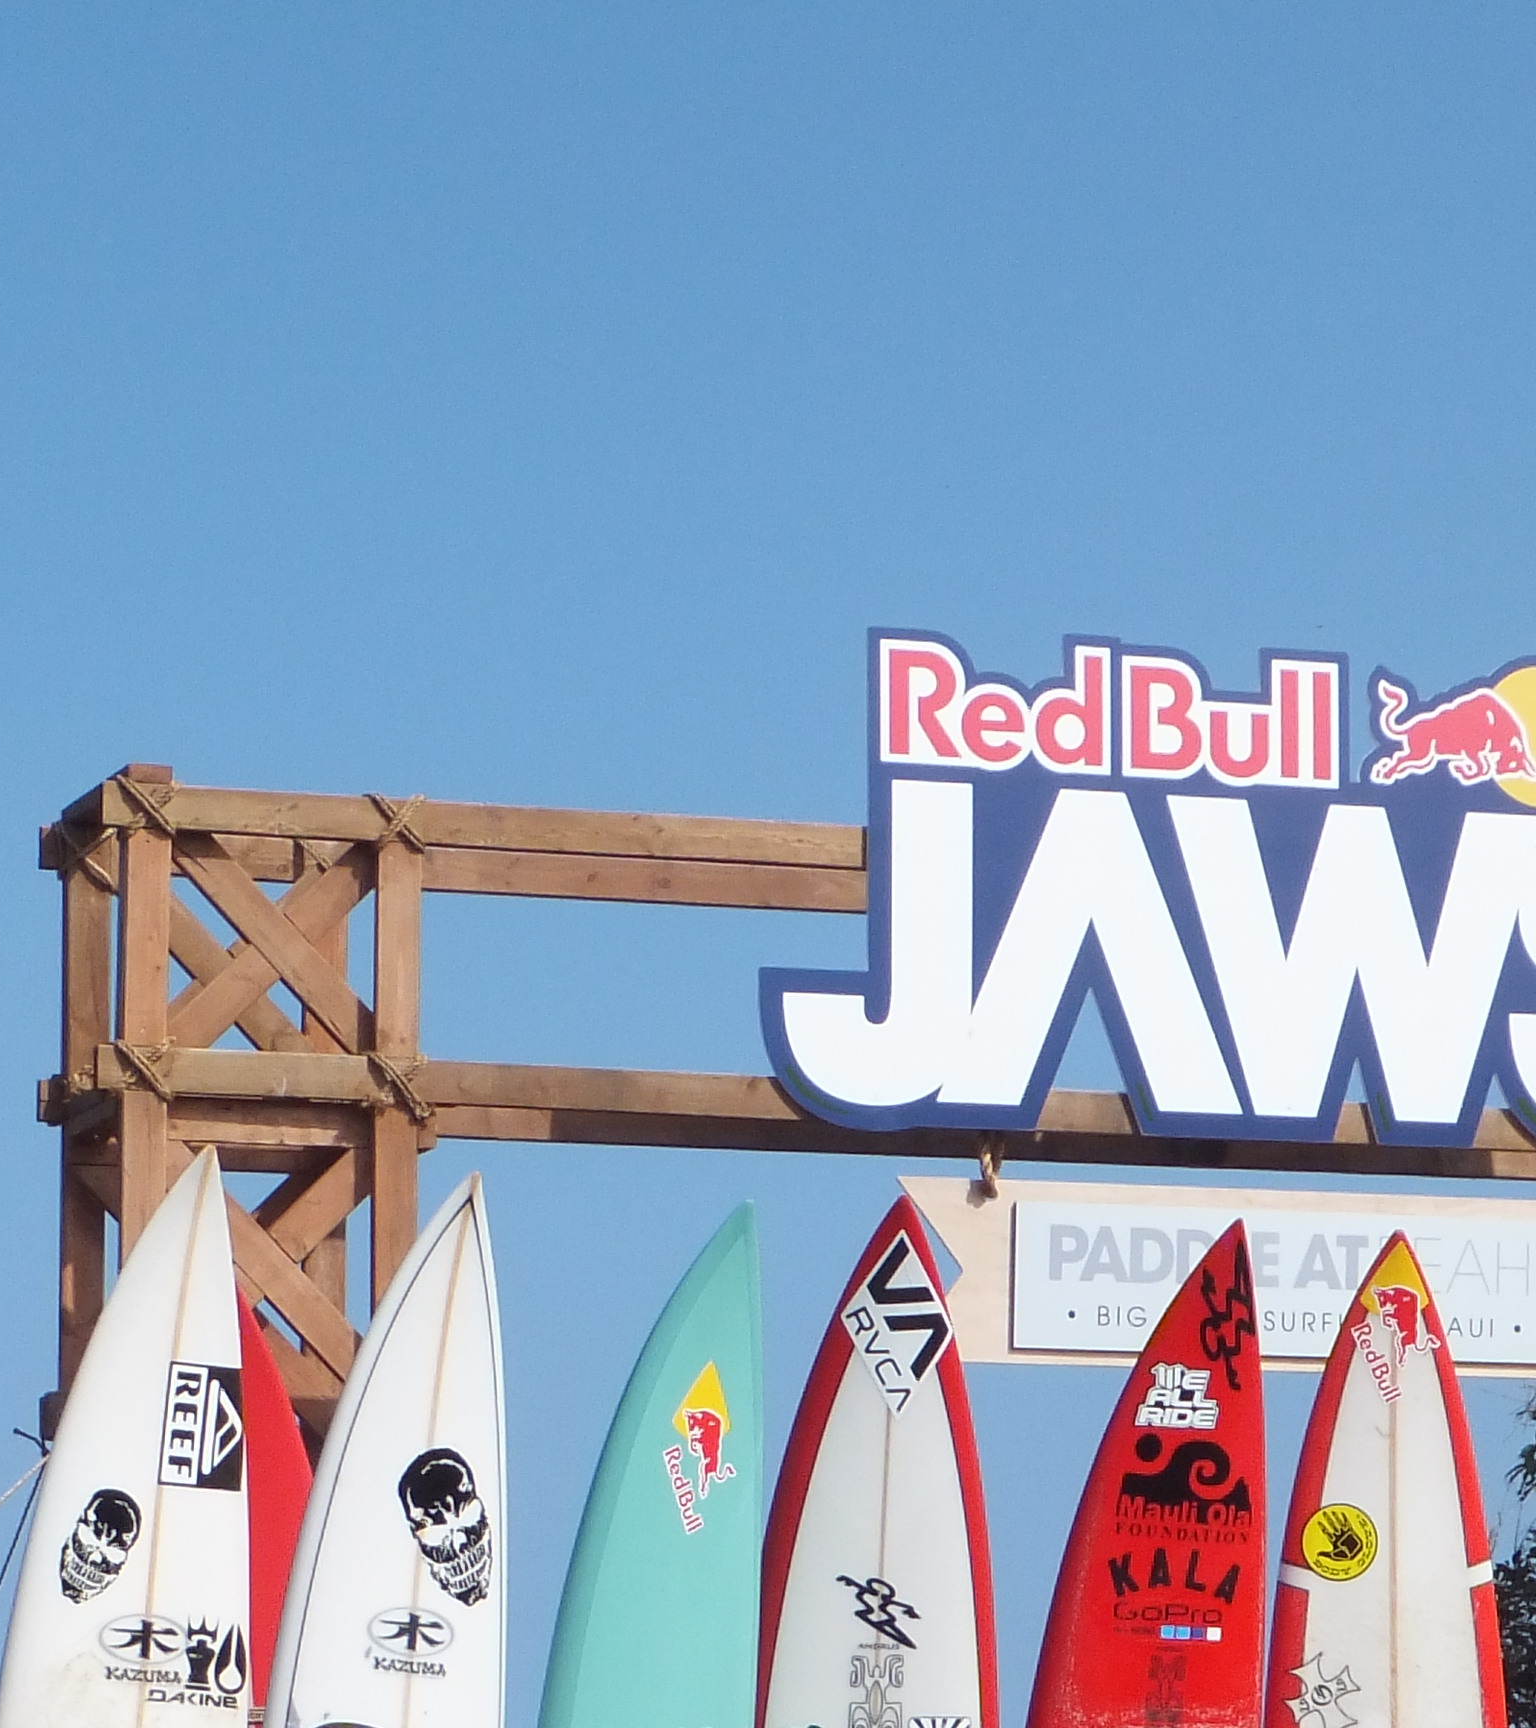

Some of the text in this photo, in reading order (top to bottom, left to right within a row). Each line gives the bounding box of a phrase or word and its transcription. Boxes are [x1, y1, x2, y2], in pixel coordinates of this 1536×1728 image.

[886, 643, 1334, 784] Red Bull
[1048, 1223, 1280, 1290] PADDE
[1293, 1233, 1369, 1291] AT
[1096, 1306, 1495, 1339] BIG SURFI AUI
[1355, 1322, 1401, 1402] Red Bull
[163, 1367, 203, 1482] REEF
[1136, 1406, 1217, 1428] RIDE
[664, 1446, 704, 1533] Red Bull
[1107, 1548, 1241, 1604] KALA
[1113, 1600, 1224, 1625] GoPro
[104, 1666, 181, 1684] KAZUMA
[373, 1656, 446, 1677] KAZUMA
[147, 1688, 239, 1710] DAKINE
